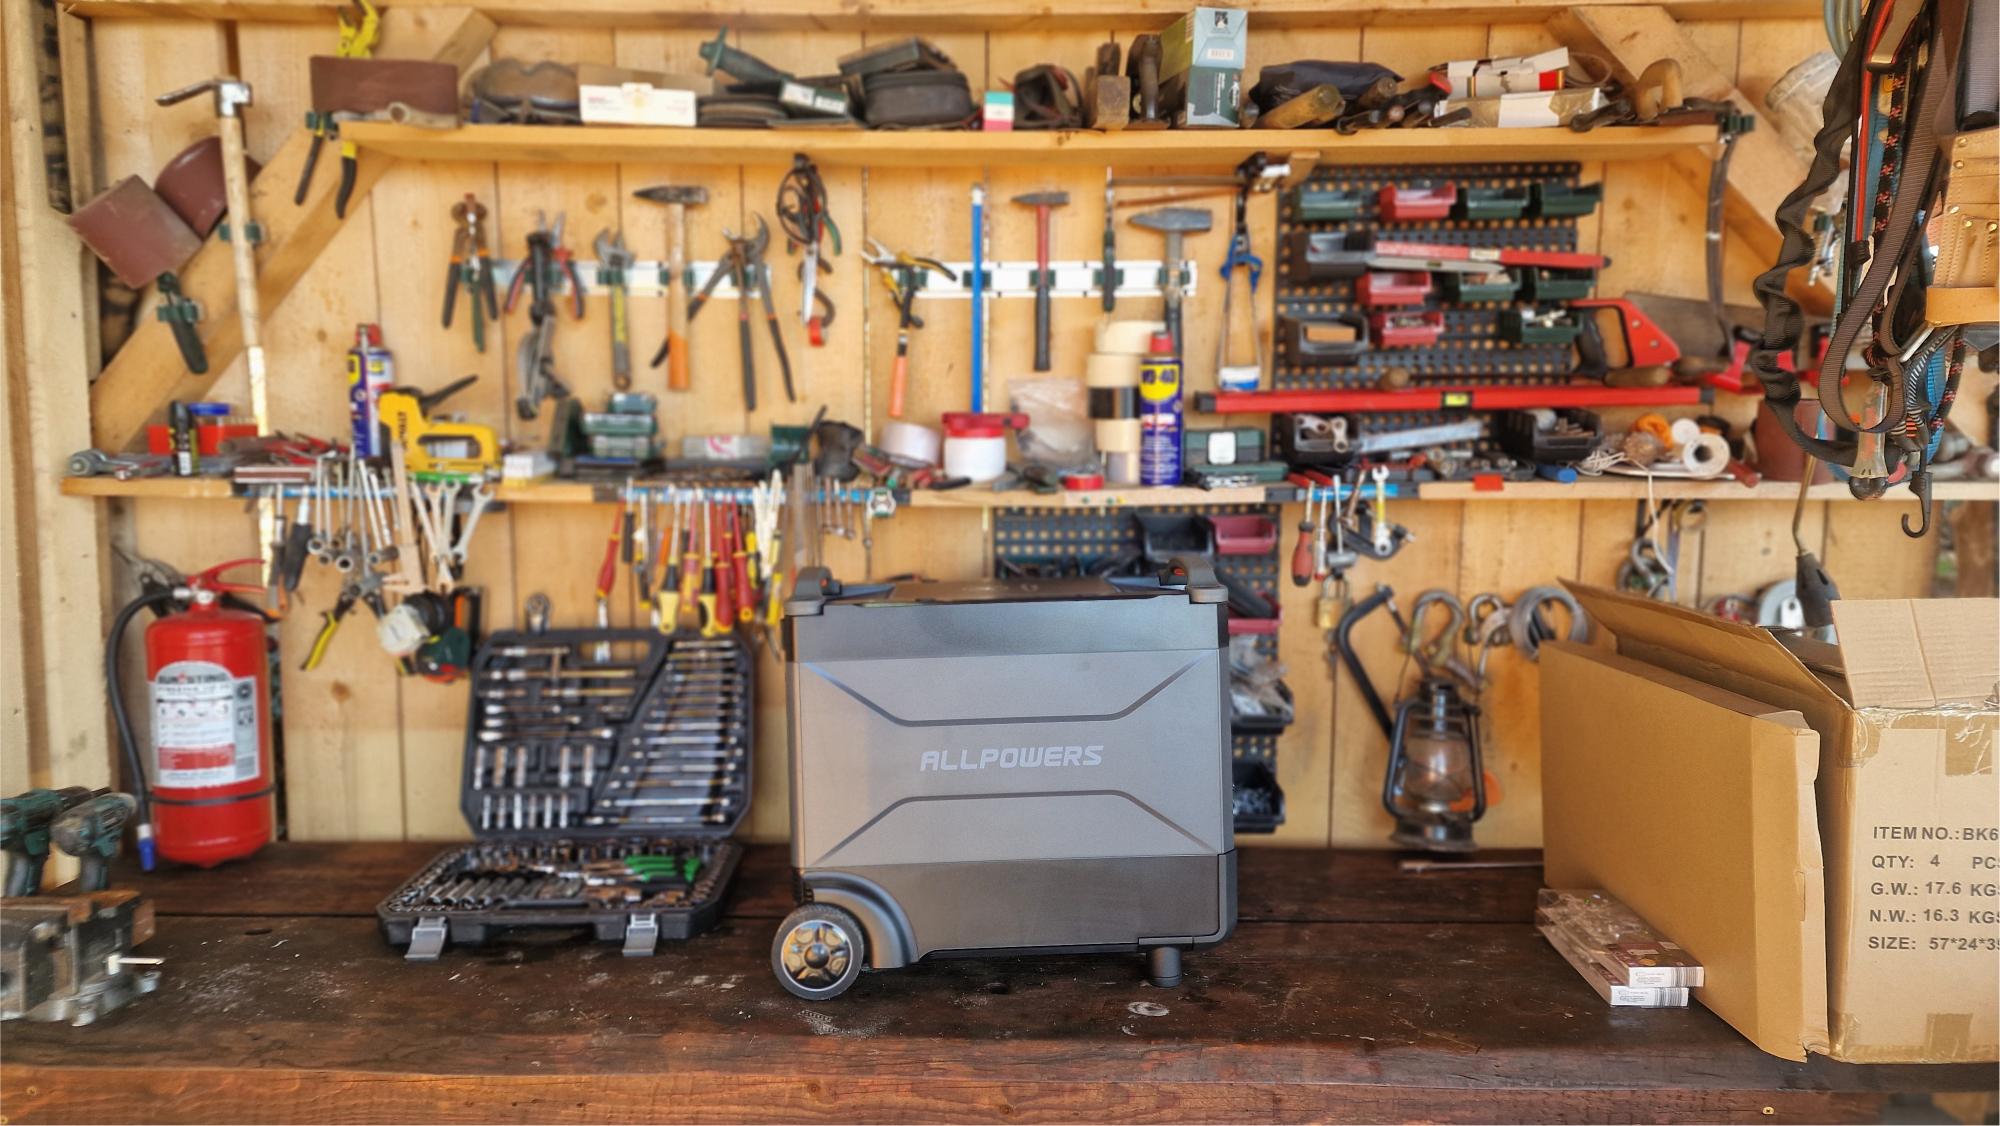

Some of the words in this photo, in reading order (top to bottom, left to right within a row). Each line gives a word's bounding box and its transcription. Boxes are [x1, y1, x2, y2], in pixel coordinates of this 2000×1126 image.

[920, 745, 1104, 772] ALLPOWERS
[1873, 826, 1917, 840] ITEM
[1872, 855, 1914, 869] QTY:
[1930, 854, 1941, 867] 4
[1972, 856, 1999, 869] PC
[1871, 882, 1918, 896] G.W.:
[1925, 881, 1962, 895] 17.6
[1970, 883, 1999, 897] KG
[1869, 909, 1916, 923] N.W.:
[1923, 908, 1960, 922] 16.3
[1868, 936, 1916, 950] SIZE:
